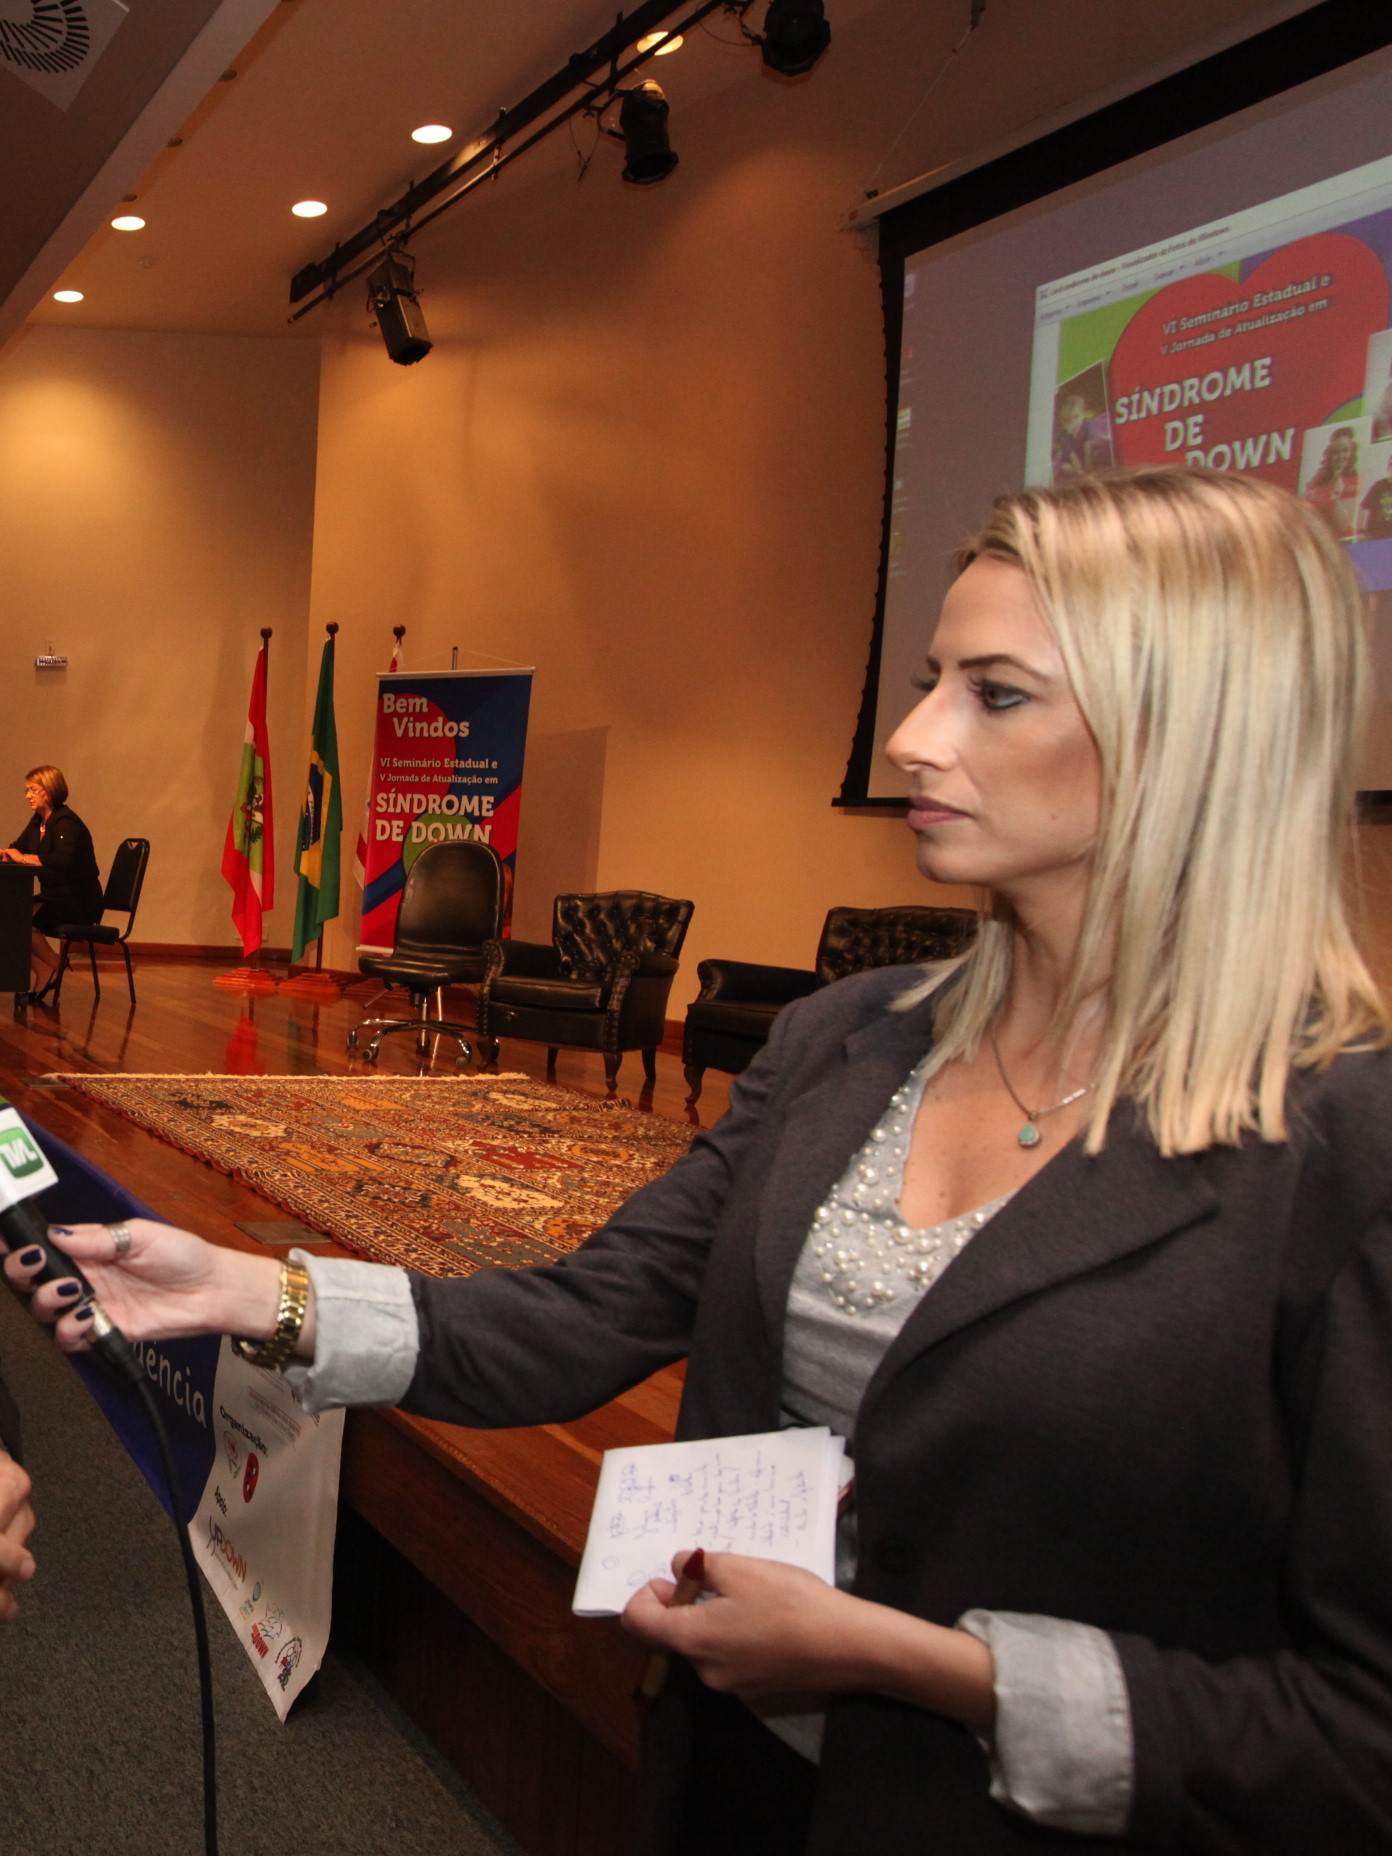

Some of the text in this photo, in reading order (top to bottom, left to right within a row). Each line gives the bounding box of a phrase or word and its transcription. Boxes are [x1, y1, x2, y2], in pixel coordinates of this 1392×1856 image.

[1162, 320, 1178, 335] VI
[1253, 274, 1318, 308] Estadual
[1320, 275, 1331, 287] e
[1170, 331, 1215, 354] Jornada
[1217, 327, 1232, 340] de
[1308, 298, 1329, 313] em
[1114, 356, 1272, 425] SÍNDROME
[1164, 413, 1204, 452] DE
[383, 693, 428, 714] Bem
[392, 716, 470, 738] Vindos
[380, 757, 498, 770] VI Seminário Estadual e
[379, 773, 499, 786] V Jornada de Atualização em
[375, 787, 495, 817] SÍNDROME
[375, 819, 492, 845] DE DOWN
